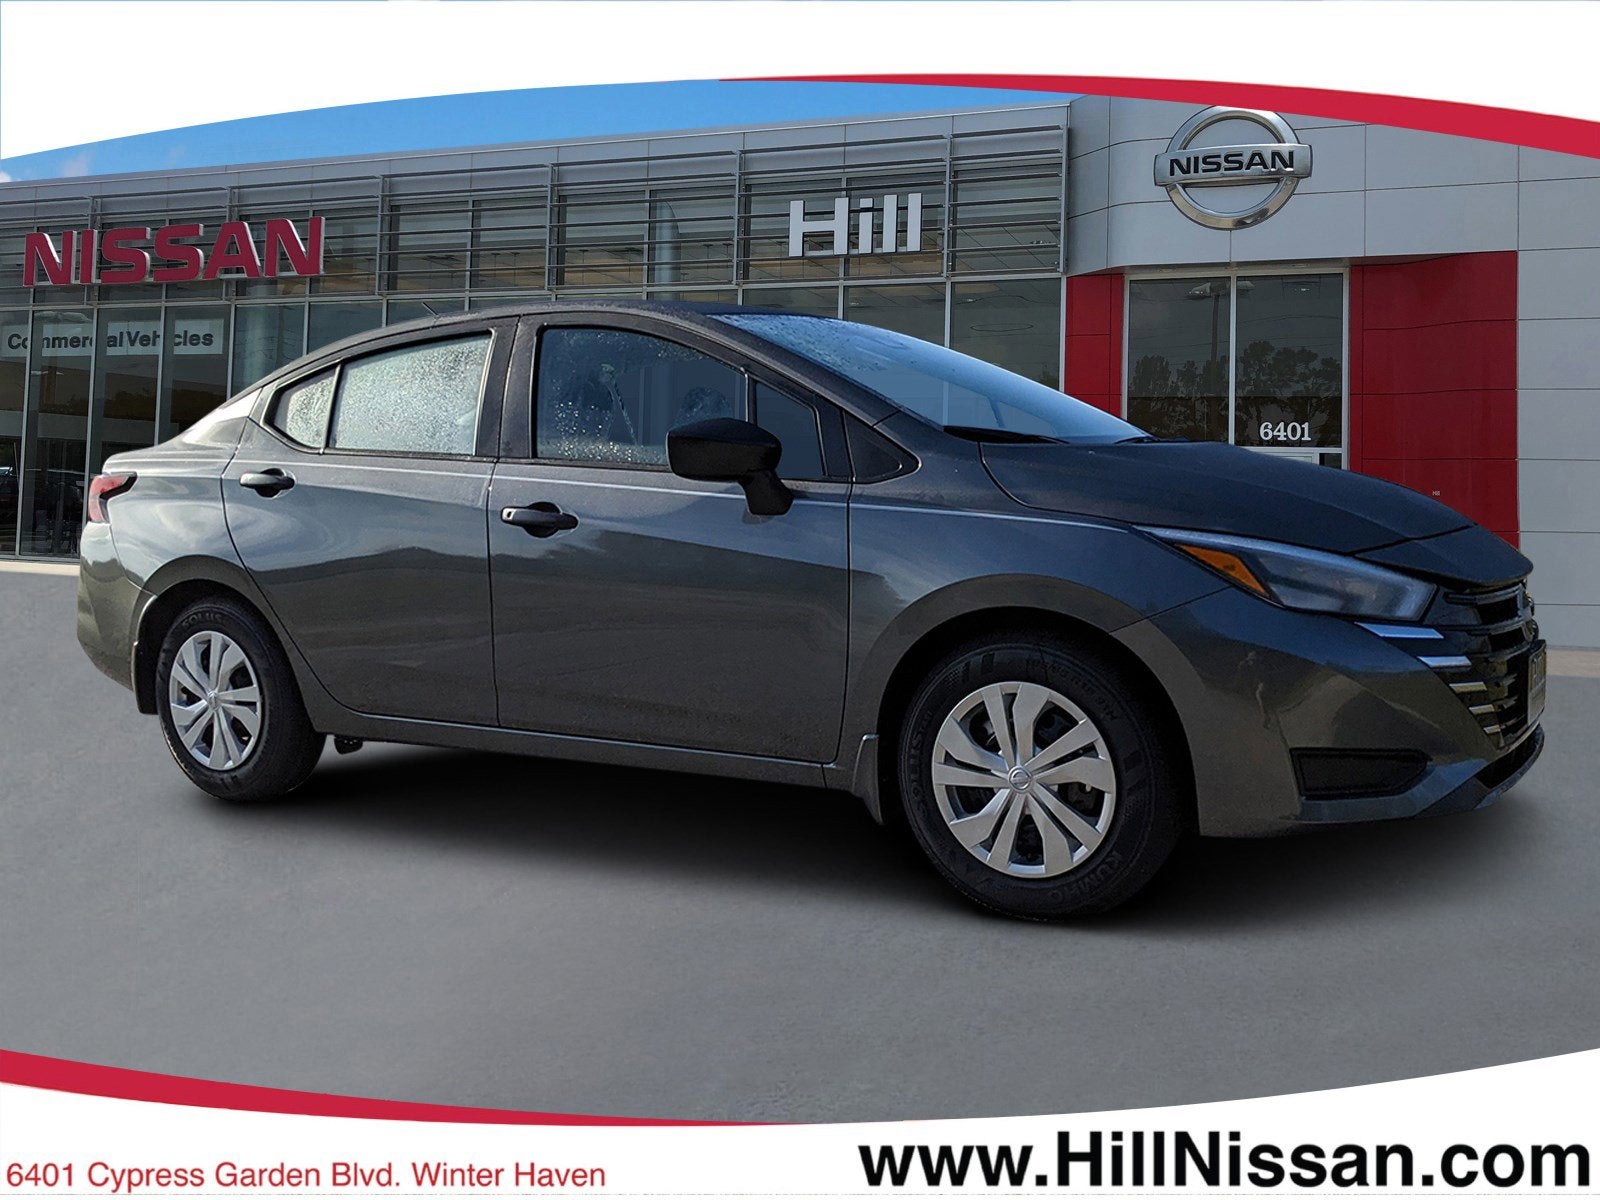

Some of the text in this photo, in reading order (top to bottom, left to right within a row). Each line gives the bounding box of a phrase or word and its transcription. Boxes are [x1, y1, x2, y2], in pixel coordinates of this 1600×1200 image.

[1169, 151, 1294, 177] NISSAN
[788, 193, 922, 257] Hill
[23, 216, 325, 287] NISSAN
[7, 330, 214, 350] Commeral Vehcles
[1260, 421, 1312, 441] 6401
